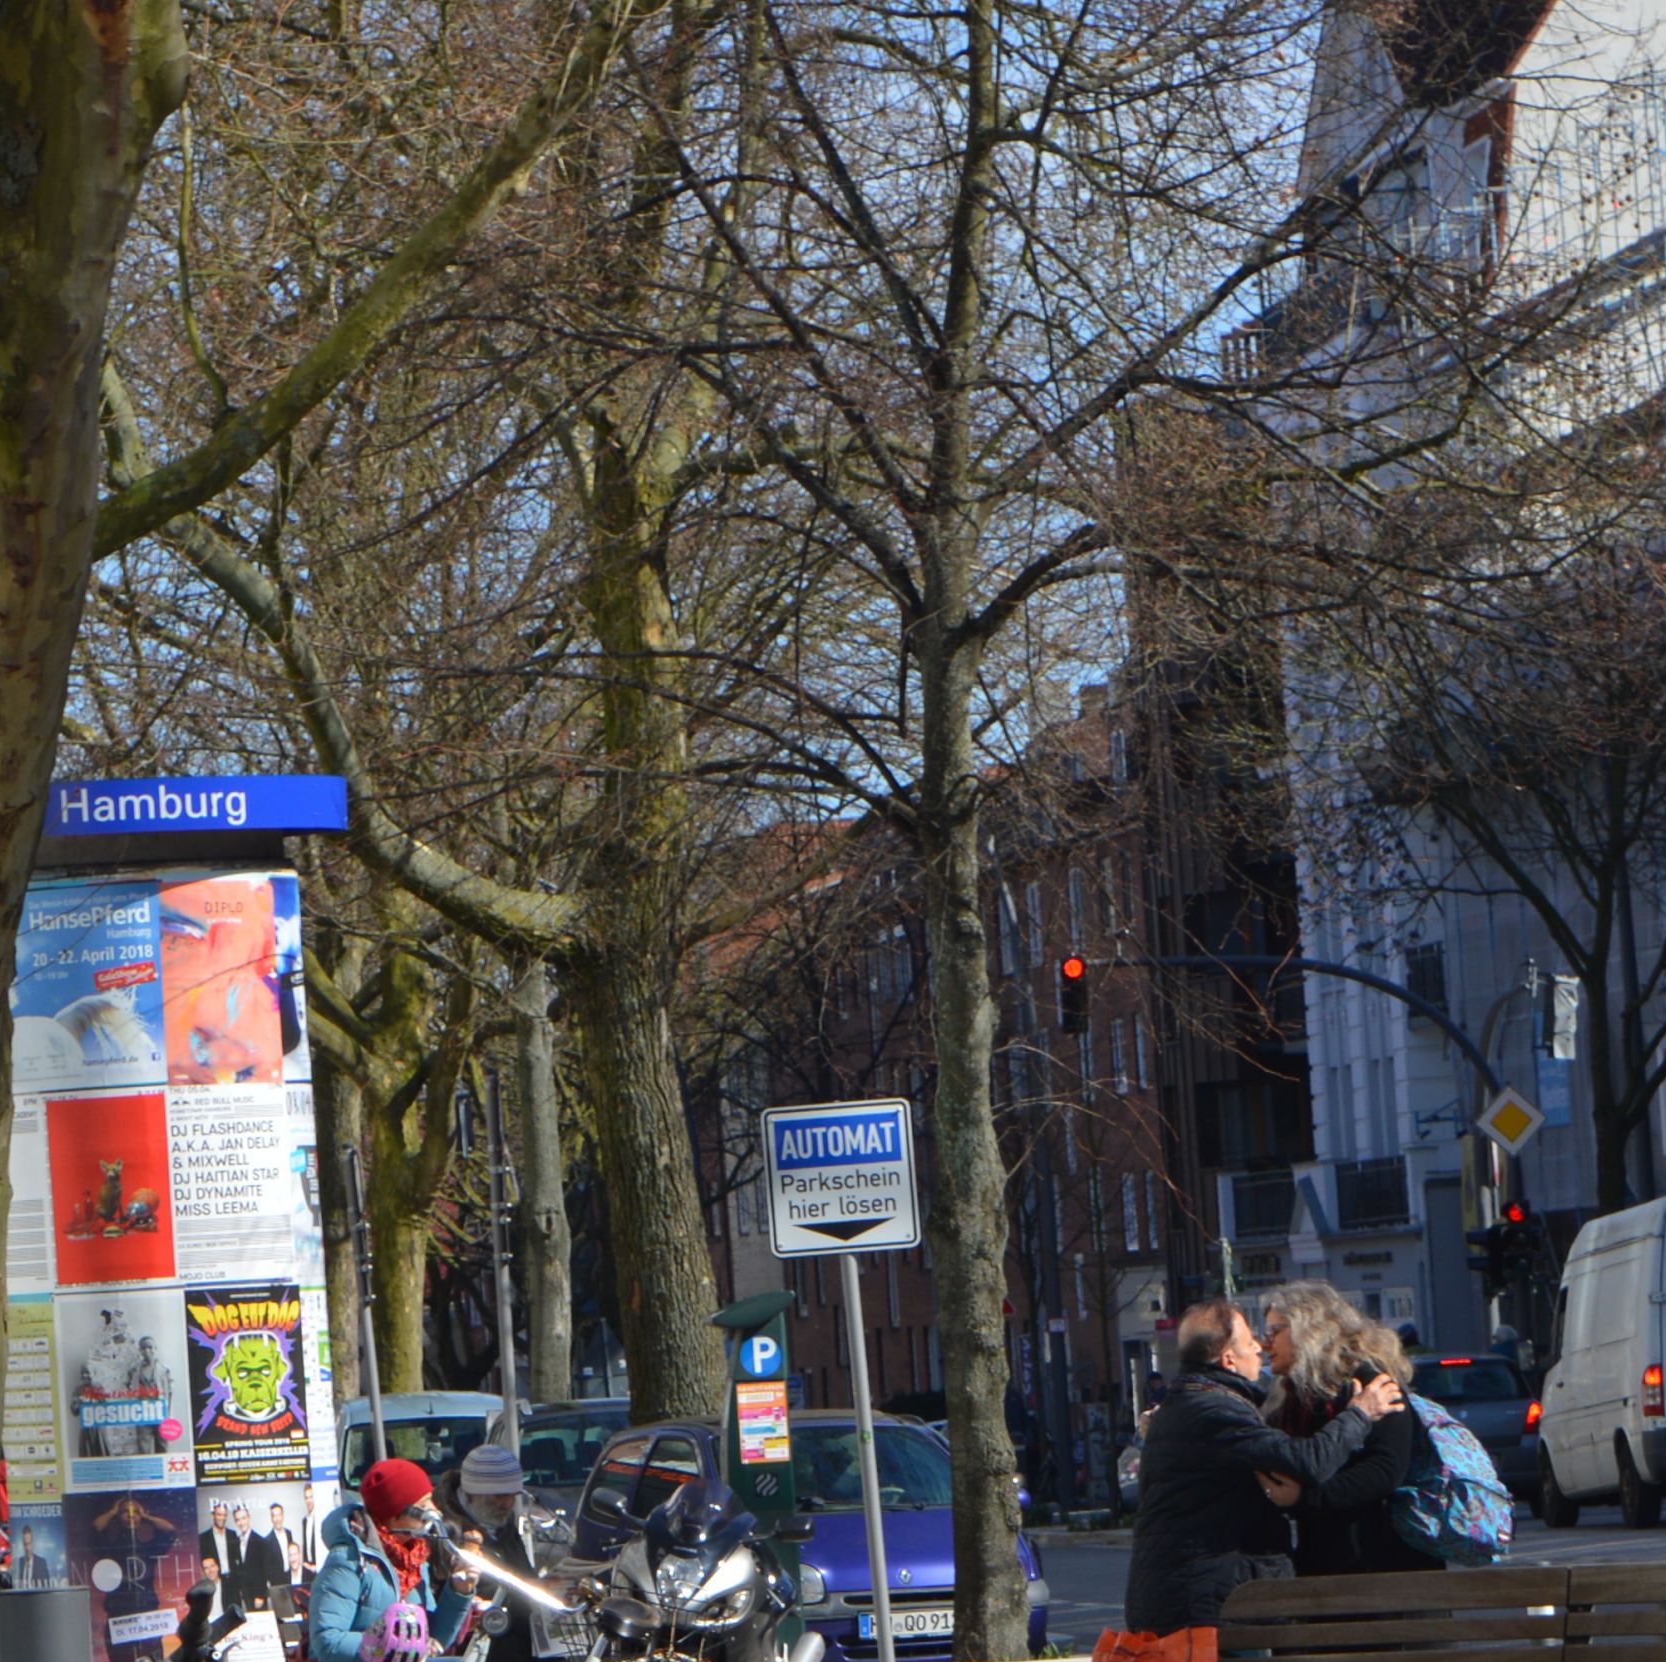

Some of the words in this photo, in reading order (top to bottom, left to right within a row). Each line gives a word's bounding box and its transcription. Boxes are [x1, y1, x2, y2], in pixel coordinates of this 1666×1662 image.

[60, 784, 248, 826] Hamburg
[28, 901, 151, 931] HansePferd
[106, 927, 152, 939] Hamburg
[80, 946, 115, 967] April
[119, 944, 154, 960] 2018
[171, 1124, 188, 1138] DJ
[193, 1120, 275, 1136] FLASHDANCE
[171, 1141, 215, 1154] A.K.A.
[218, 1137, 244, 1151] JAN
[247, 1136, 280, 1150] DELAY
[781, 1122, 895, 1161] AUTOMAT
[172, 1156, 183, 1169] &
[188, 1154, 250, 1168] MIXWELL
[173, 1173, 190, 1185] DJ
[195, 1169, 249, 1184] HAITIAN
[252, 1168, 279, 1181] STAR
[780, 1167, 901, 1194] Parkschein
[174, 1188, 191, 1201] DJ
[196, 1185, 263, 1200] DYNAMITE
[175, 1203, 212, 1217] MISS
[215, 1201, 259, 1216] LEEMA
[789, 1199, 830, 1220] hier
[839, 1195, 897, 1215] lösen
[205, 1270, 226, 1279] CLUB
[187, 1303, 239, 1337] DOG
[267, 1300, 300, 1332] DOG
[752, 1336, 778, 1374] P
[82, 1399, 165, 1427] gesucht
[70, 1553, 195, 1592] NORTH
[930, 1612, 955, 1630] 91
